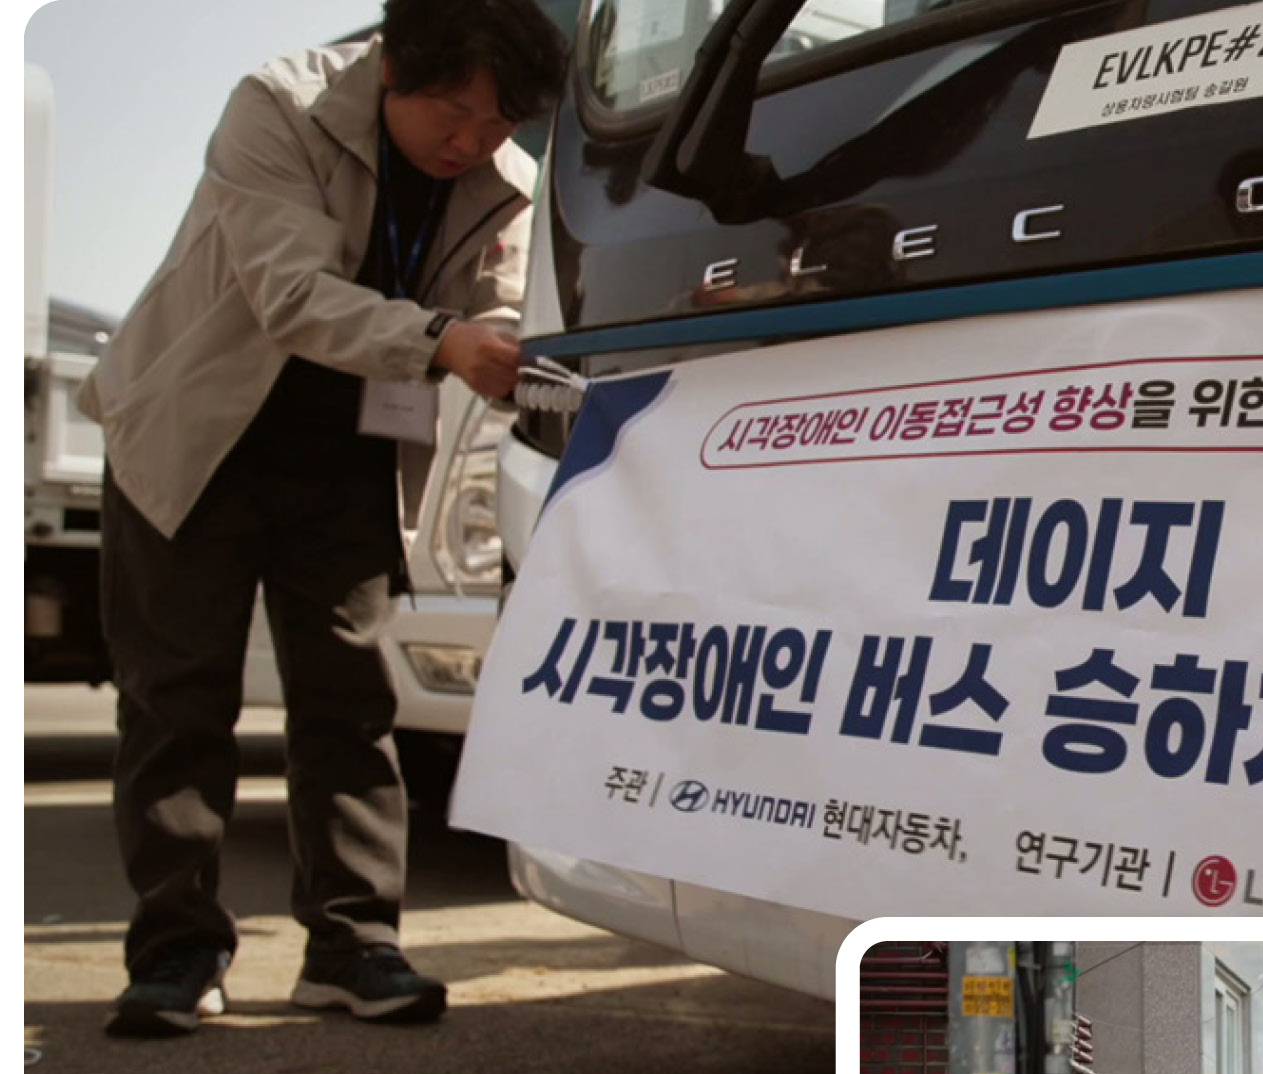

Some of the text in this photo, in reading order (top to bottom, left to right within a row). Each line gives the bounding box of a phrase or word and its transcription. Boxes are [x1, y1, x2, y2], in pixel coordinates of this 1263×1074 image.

[717, 406, 869, 454] 시각장애인
[868, 388, 1046, 442] 이동접근성
[1048, 379, 1176, 432] 향상을
[927, 496, 1226, 619] 데이지
[520, 616, 834, 736] 시각장애인
[838, 635, 1011, 757] 버스
[603, 765, 649, 803] 주관
[710, 787, 817, 830] HYUNDAI
[1014, 829, 1152, 892] 연구기관
